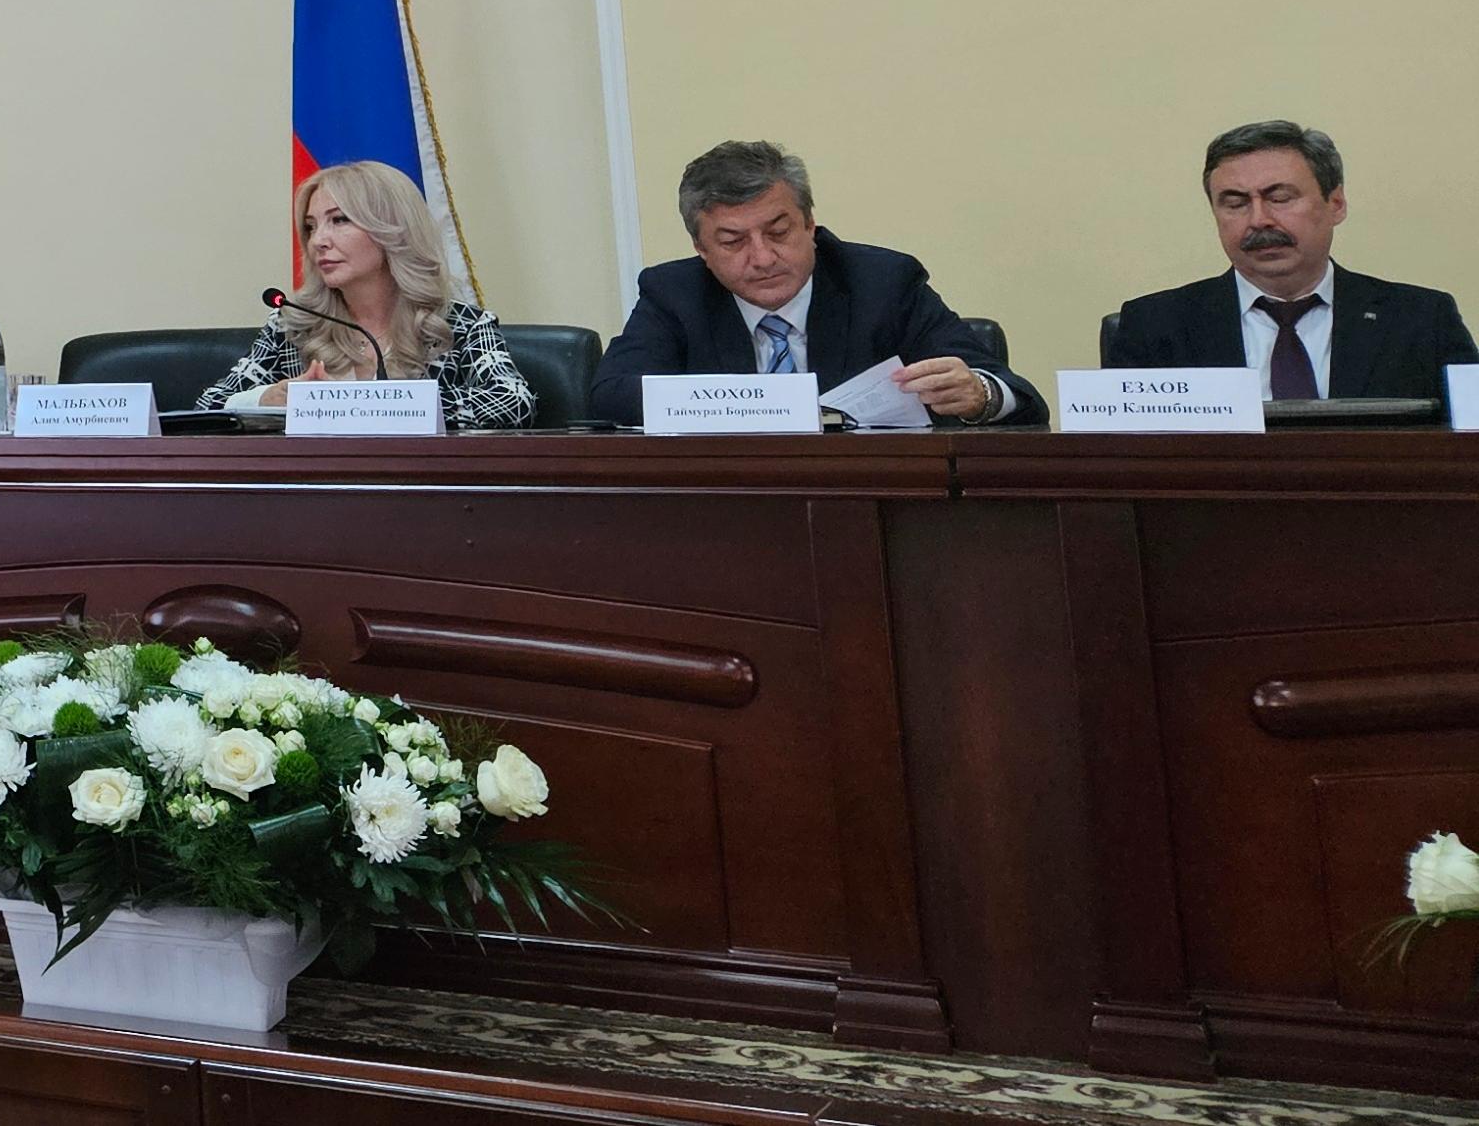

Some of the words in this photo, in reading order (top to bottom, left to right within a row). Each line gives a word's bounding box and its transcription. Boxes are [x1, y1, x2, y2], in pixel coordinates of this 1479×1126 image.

[305, 387, 414, 401] АТМУРЗАЕВА
[689, 387, 765, 401] АХОХОВ
[1121, 380, 1190, 395] ЕЗАОВ
[35, 397, 128, 411] МАЛЬБАХОВ
[1067, 402, 1118, 416] Анзор
[1122, 401, 1234, 415] Клишбиевич
[292, 406, 347, 420] Земфира
[349, 406, 427, 418] Солтановна
[725, 406, 791, 417] Борисович
[31, 415, 60, 425] Алим
[62, 414, 129, 426] Амурбиевич
